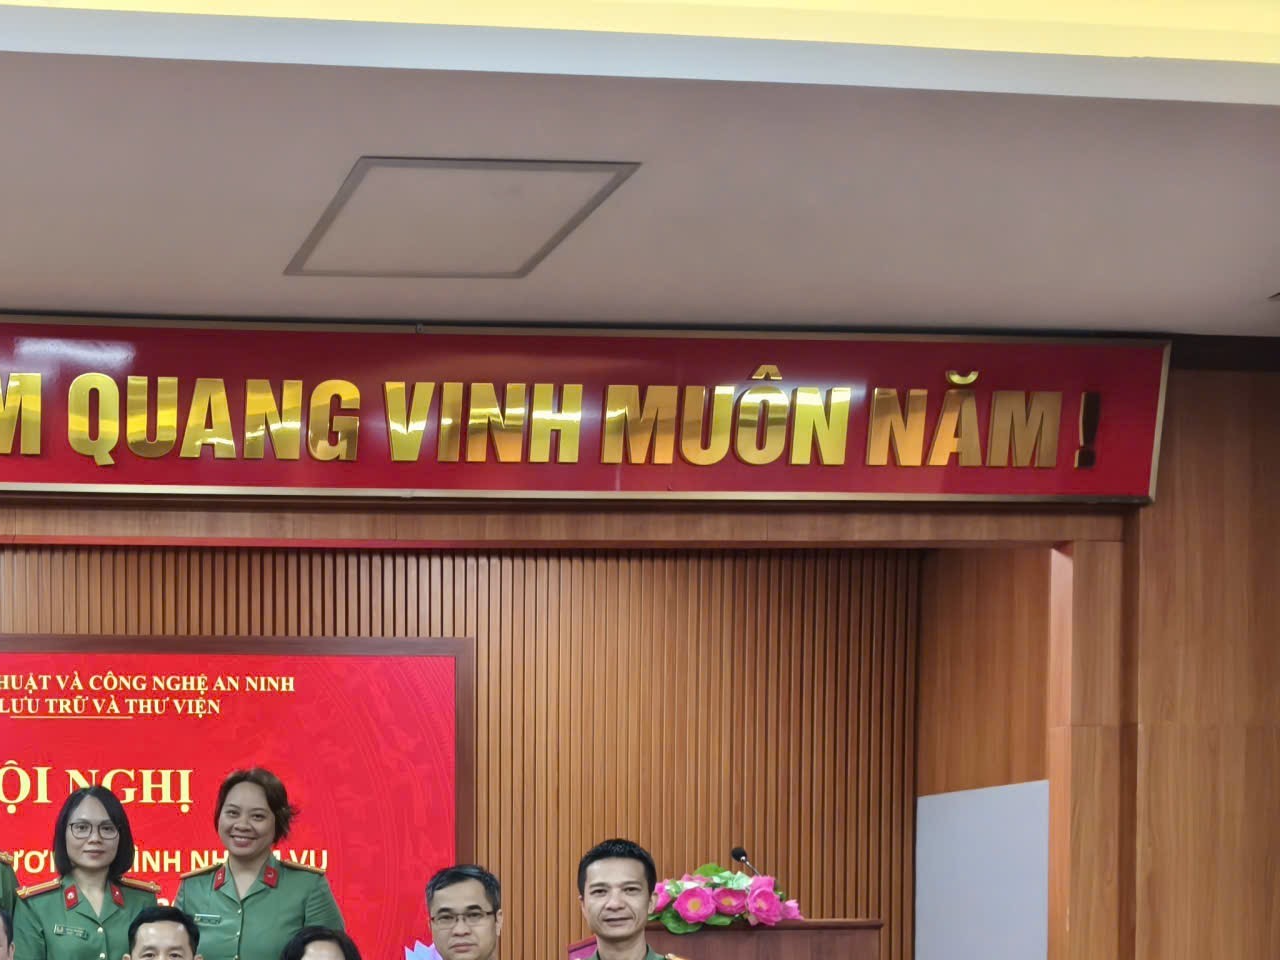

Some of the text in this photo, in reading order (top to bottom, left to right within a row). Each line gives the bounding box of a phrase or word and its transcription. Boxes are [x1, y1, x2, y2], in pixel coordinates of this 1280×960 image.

[68, 372, 360, 466] QUANG
[384, 380, 584, 464] VINH
[601, 364, 852, 466] MUÔN
[866, 370, 1063, 468] NĂM
[56, 671, 83, 690] VÀ
[89, 671, 147, 691] CÔNG
[153, 674, 208, 695] NGHỆ
[213, 676, 239, 691] AN
[245, 676, 295, 692] NINH
[45, 695, 89, 714] TRỮ
[92, 695, 120, 714] VÀ
[125, 696, 169, 714] THƯ
[173, 698, 220, 718] VIỆN
